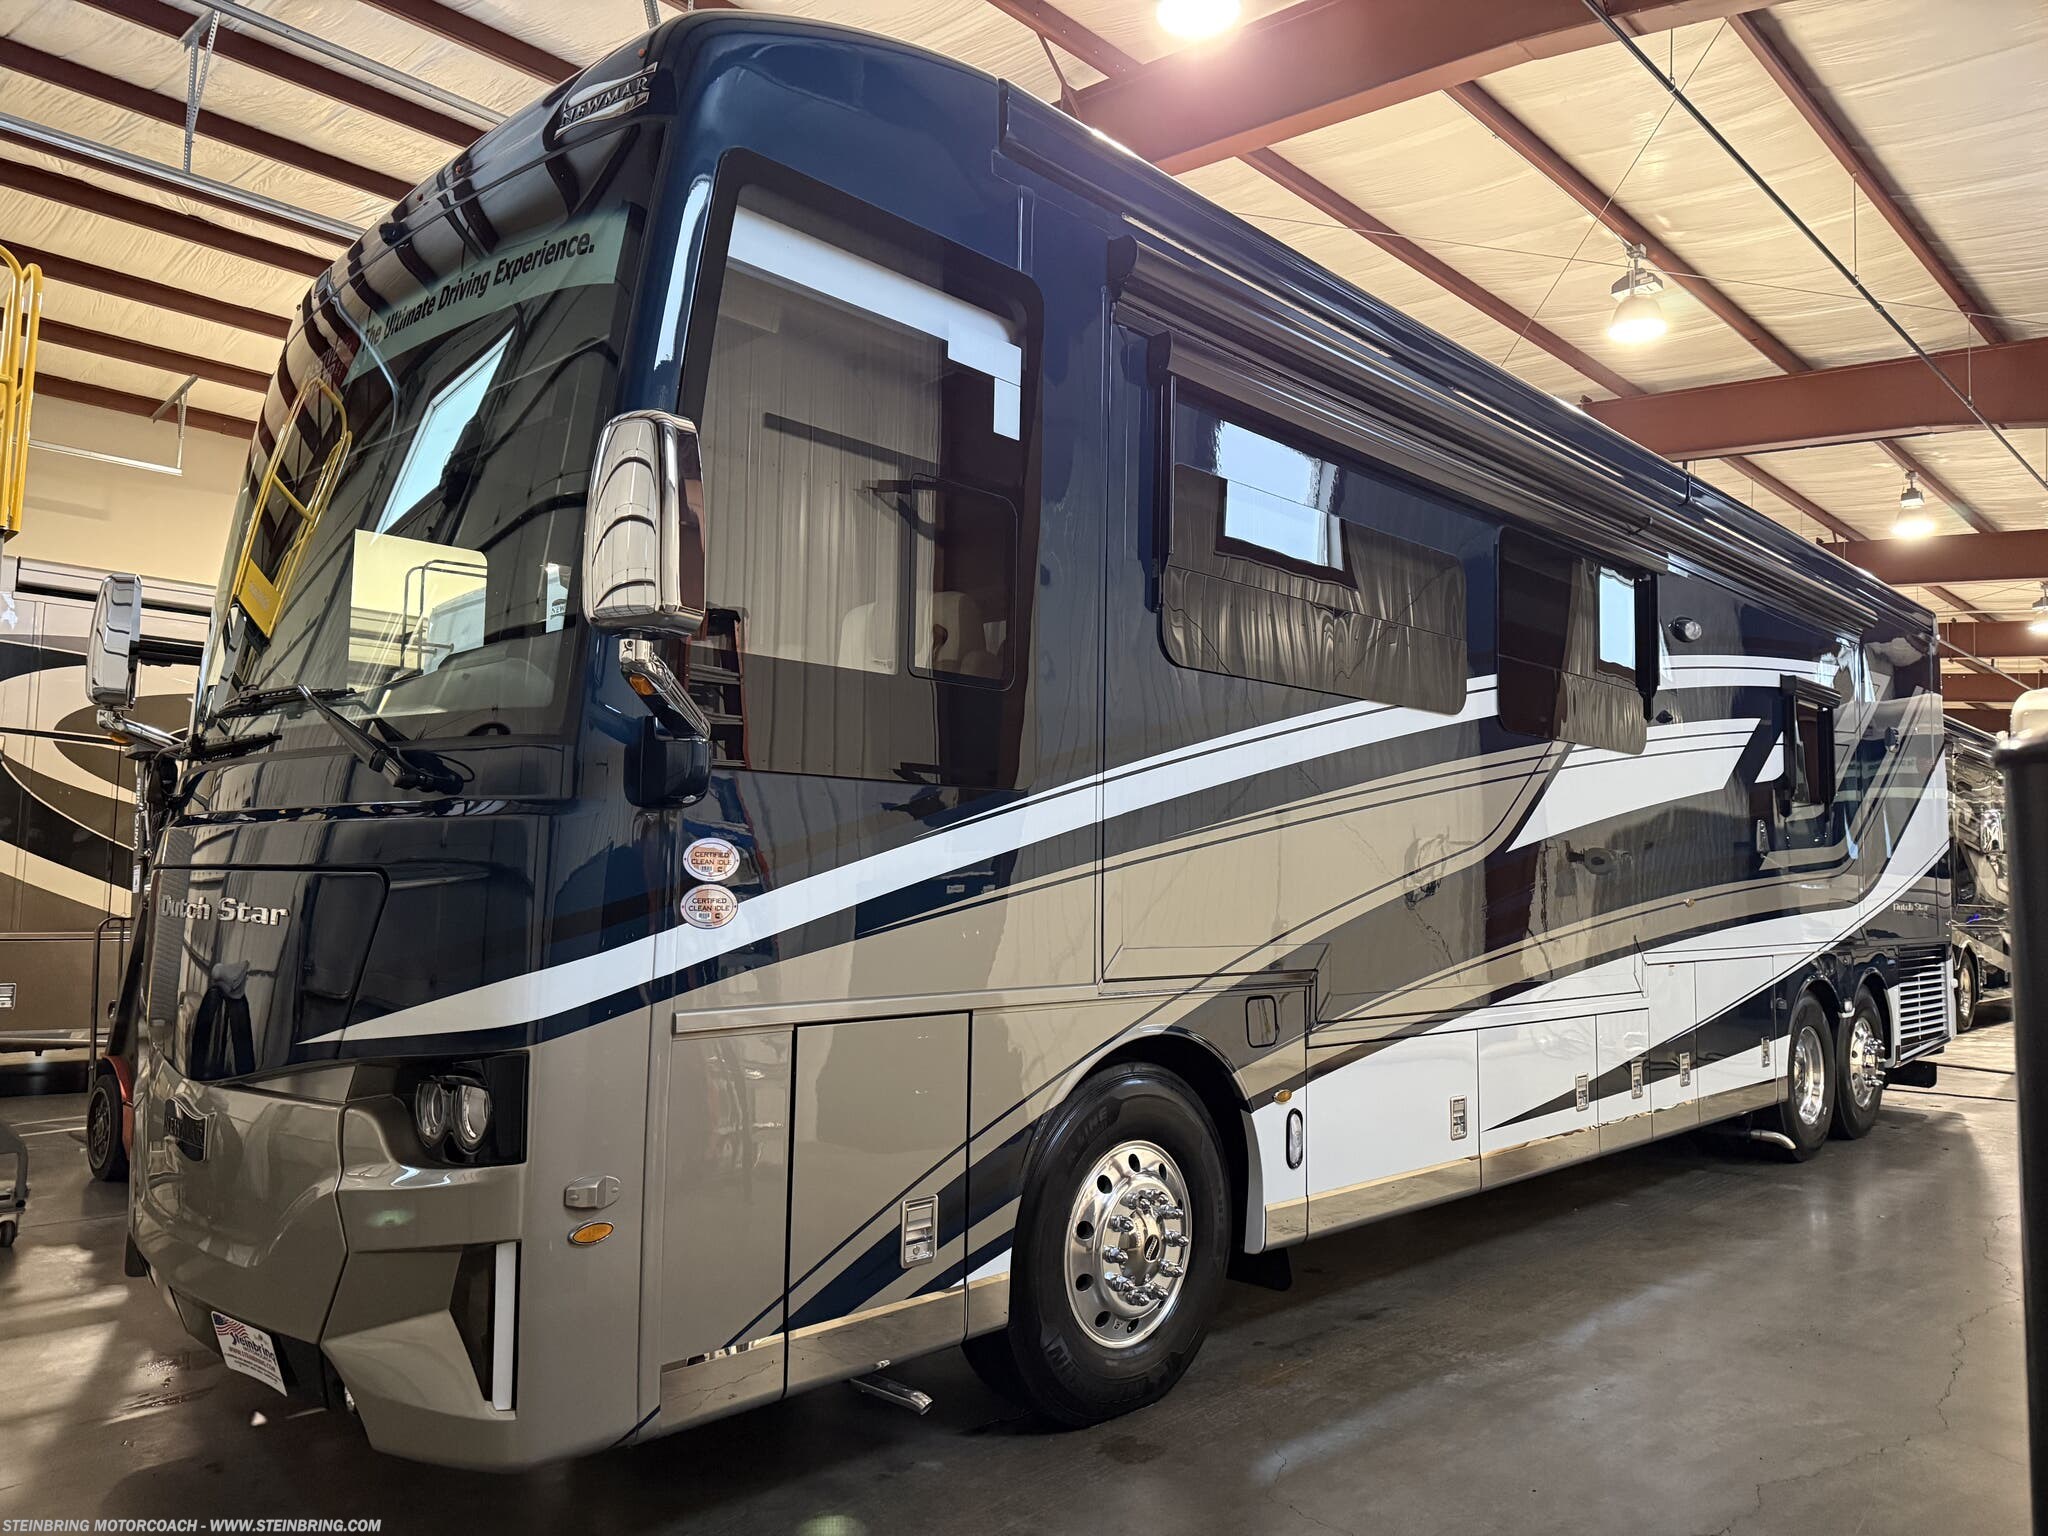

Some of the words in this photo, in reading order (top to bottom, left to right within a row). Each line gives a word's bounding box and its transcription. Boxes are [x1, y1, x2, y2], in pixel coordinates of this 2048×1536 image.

[559, 77, 650, 128] NEWMAR
[384, 293, 436, 339] Ultimate
[437, 271, 491, 311] Driving
[493, 233, 595, 285] Experience.
[160, 894, 212, 921] Dutch
[217, 897, 290, 927] Star
[688, 904, 712, 912] CLEAN
[714, 904, 730, 912] IDLE
